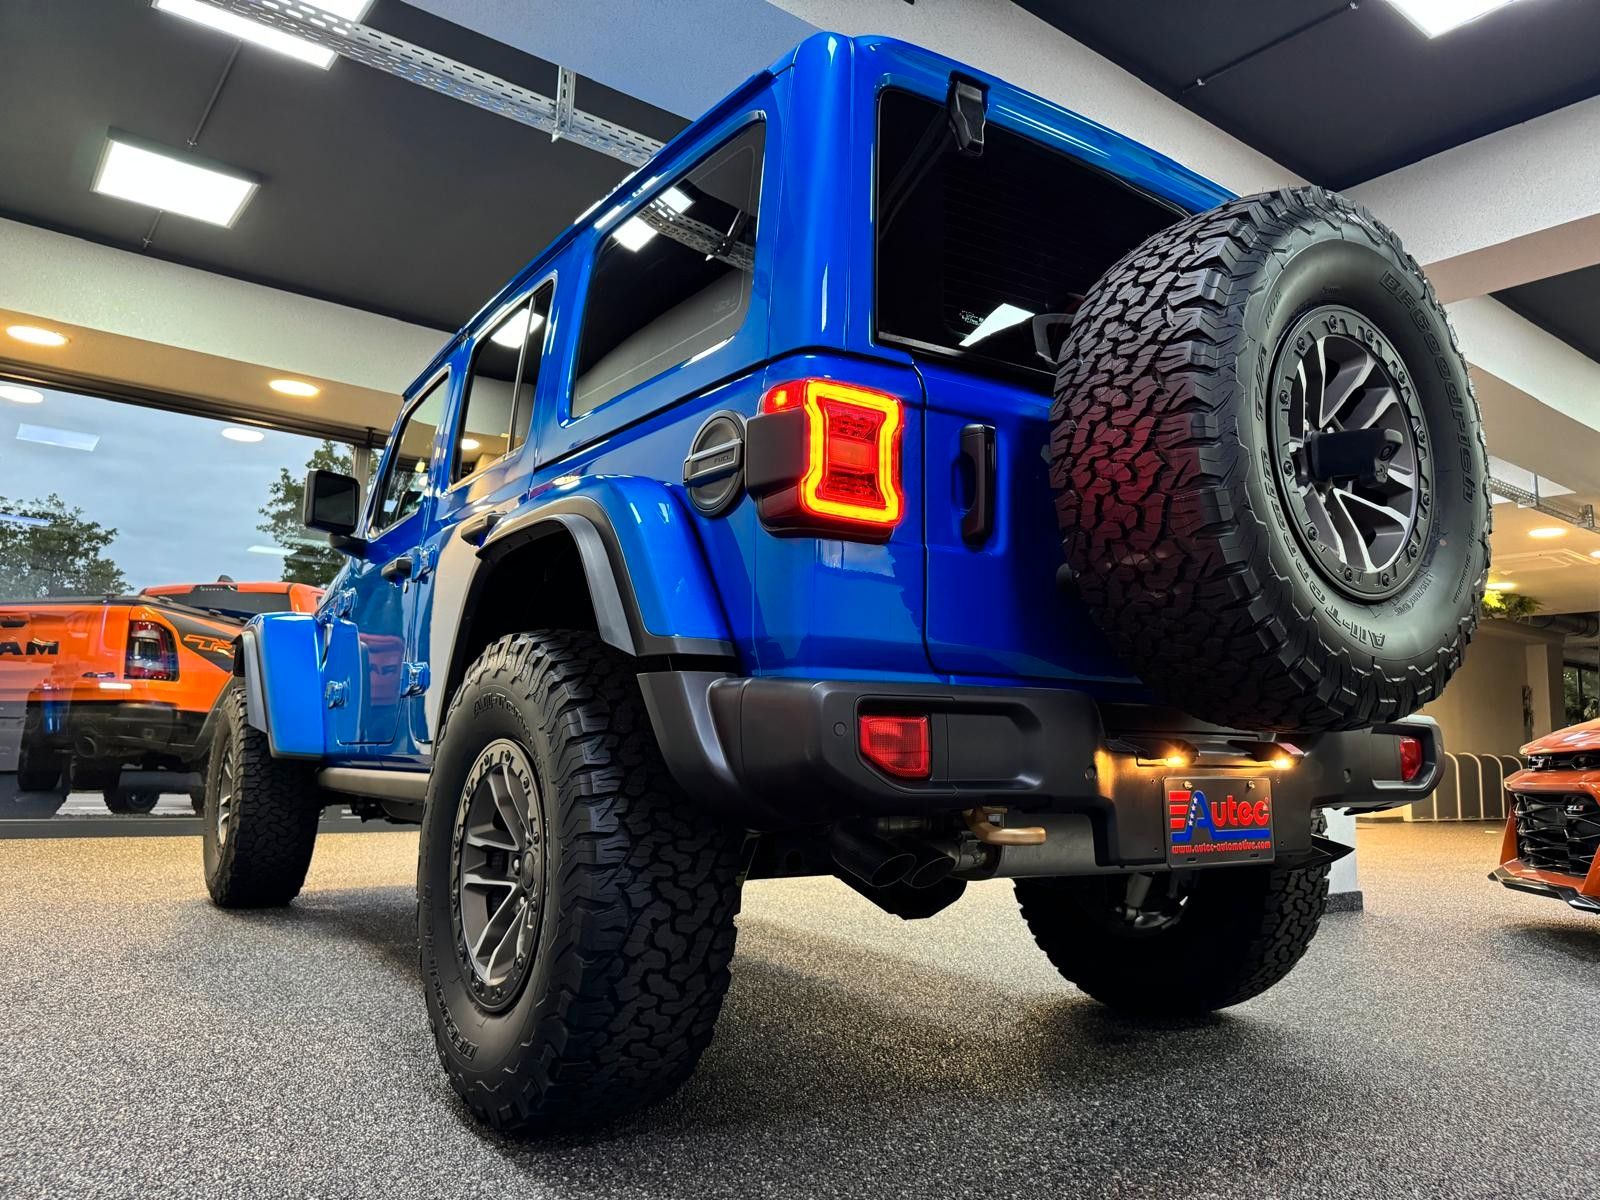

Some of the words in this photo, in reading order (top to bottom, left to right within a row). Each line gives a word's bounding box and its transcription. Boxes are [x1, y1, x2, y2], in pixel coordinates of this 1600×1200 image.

[183, 634, 236, 658] TR
[1186, 790, 1270, 841] Autec
[1171, 840, 1271, 854] www.autec-automotive.com
